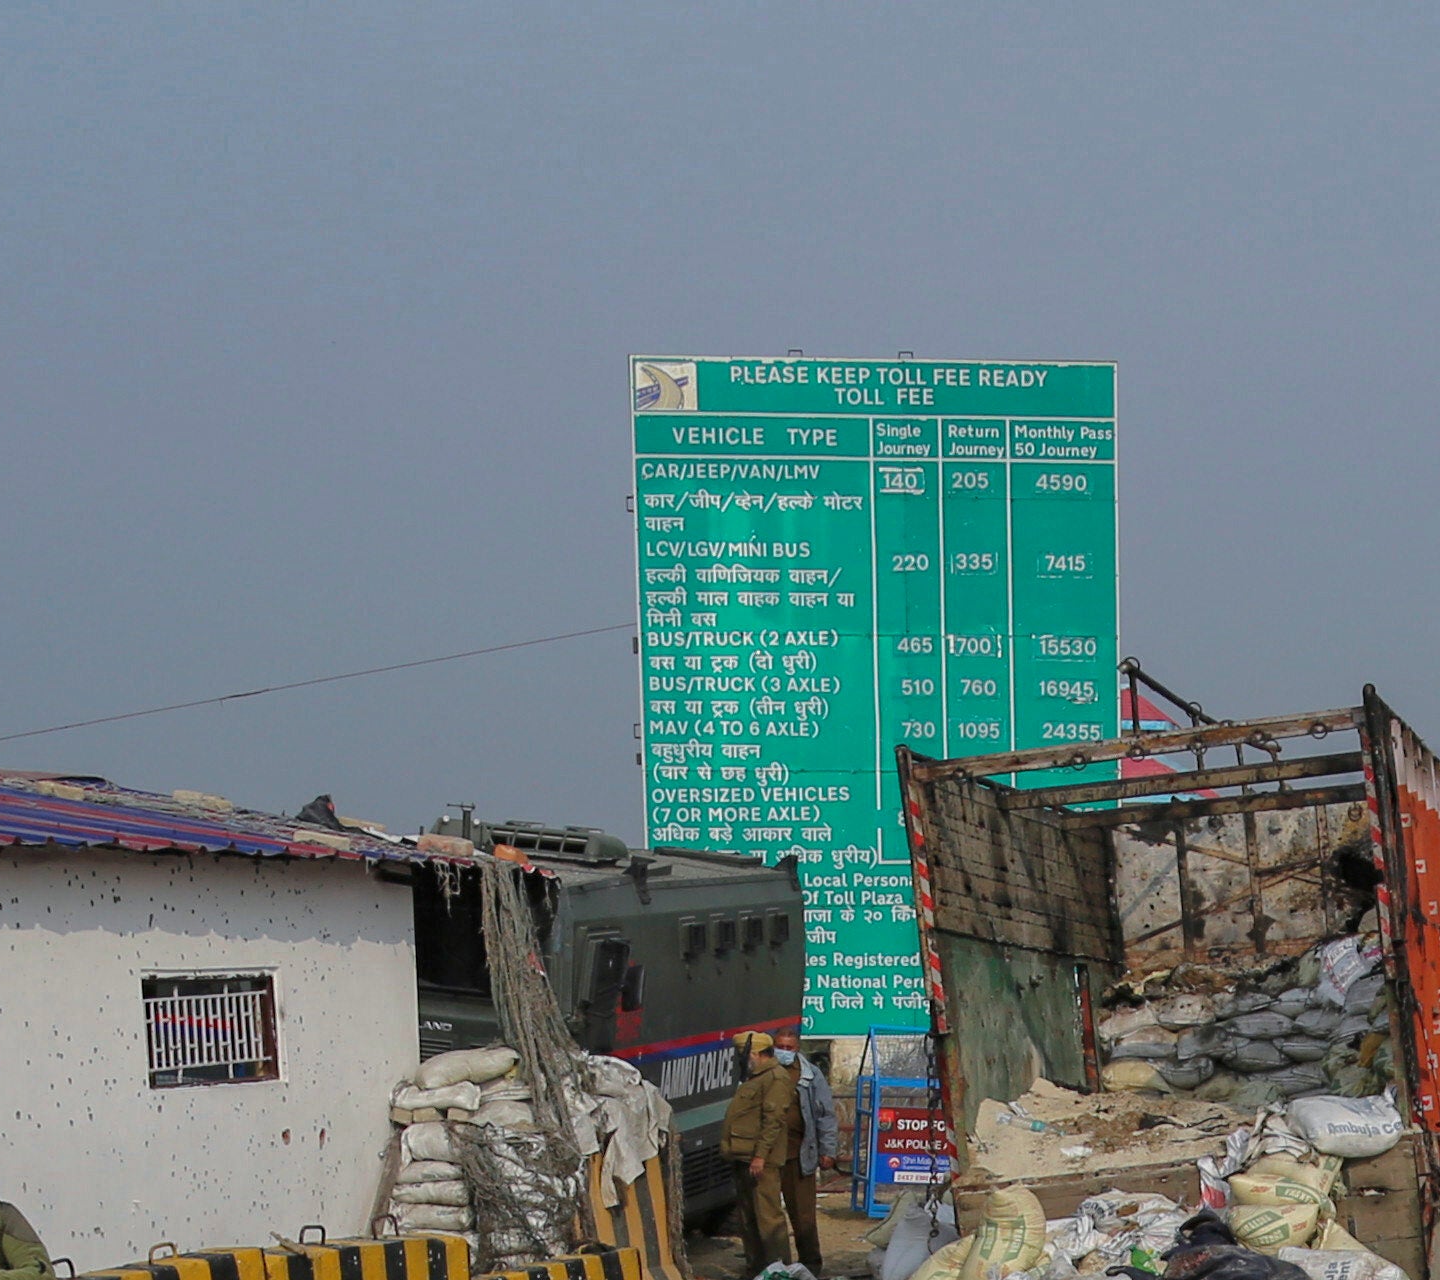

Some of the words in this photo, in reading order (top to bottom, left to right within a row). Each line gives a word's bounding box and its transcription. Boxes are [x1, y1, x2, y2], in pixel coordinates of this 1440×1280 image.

[731, 366, 808, 384] PLEASE
[817, 367, 870, 384] KEEP
[876, 368, 926, 384] TOLL
[934, 369, 970, 385] FEE
[979, 369, 1047, 387] READY
[835, 388, 884, 404] TOLL
[897, 388, 934, 405] FEE
[673, 427, 764, 444] VEHICLE
[787, 429, 837, 446] TYPE
[877, 423, 921, 439] Single
[949, 425, 999, 437] Return
[1015, 425, 1074, 442] Monthly
[1081, 427, 1112, 439] Pass
[877, 443, 930, 456] Journey
[949, 443, 1004, 459] Journey
[1016, 443, 1034, 455] 50
[1039, 443, 1097, 458] Journey
[642, 463, 819, 480] CAR/JEEP/VAN/LMV
[882, 473, 919, 490] 140
[953, 472, 988, 488] 205
[1036, 474, 1086, 491] 4590
[824, 493, 862, 509] मोटर
[645, 517, 684, 532] वाहन
[647, 541, 766, 558] LCV/LGV/MINI
[773, 542, 810, 557] BUS
[893, 554, 928, 571] 220
[957, 554, 992, 569] 335
[1046, 555, 1085, 571] 7415
[645, 564, 686, 584] हल्की
[789, 569, 841, 586] वाहन/
[646, 586, 687, 607] हल्की
[696, 592, 728, 605] माल
[737, 592, 779, 607] वाहक
[789, 593, 828, 607] वाहन
[837, 593, 854, 606] या
[646, 608, 681, 626] मिनी
[647, 631, 754, 648] BUS/TRUCK
[898, 637, 932, 653] 465
[1040, 638, 1096, 655] 15530
[684, 656, 702, 670] या
[710, 656, 738, 672] ट्रक
[650, 677, 755, 693] BUS/TRUCK
[902, 679, 934, 695] 510
[961, 679, 996, 695] 760
[1040, 681, 1096, 699] 16945
[684, 701, 702, 714] या
[711, 701, 739, 717] ट्रक
[650, 721, 688, 734] MAV
[720, 721, 743, 735] TO
[750, 722, 760, 735] 6
[902, 722, 935, 737] 730
[959, 723, 999, 738] 1095
[1043, 723, 1102, 741] 24355
[722, 744, 760, 759] वाहन
[697, 763, 712, 780] से
[720, 767, 746, 781] छह
[652, 788, 754, 803] OVERSIZED
[761, 786, 849, 801] VEHICLES
[676, 808, 701, 822] OR
[709, 807, 761, 824] MORE
[653, 822, 700, 841] अधिक
[743, 828, 792, 841] आकार
[801, 823, 832, 841] वाले
[804, 873, 848, 887] Local
[824, 891, 855, 905] Toll
[861, 893, 903, 905] Plaza
[841, 906, 855, 922] के
[833, 952, 921, 969] Registered
[817, 975, 887, 989] National
[661, 1055, 696, 1100] JAMMU
[696, 1047, 735, 1094] POLICE
[897, 1119, 928, 1131] STOP
[1327, 1122, 1379, 1138] Ambuja
[885, 1139, 904, 1149] J&K
